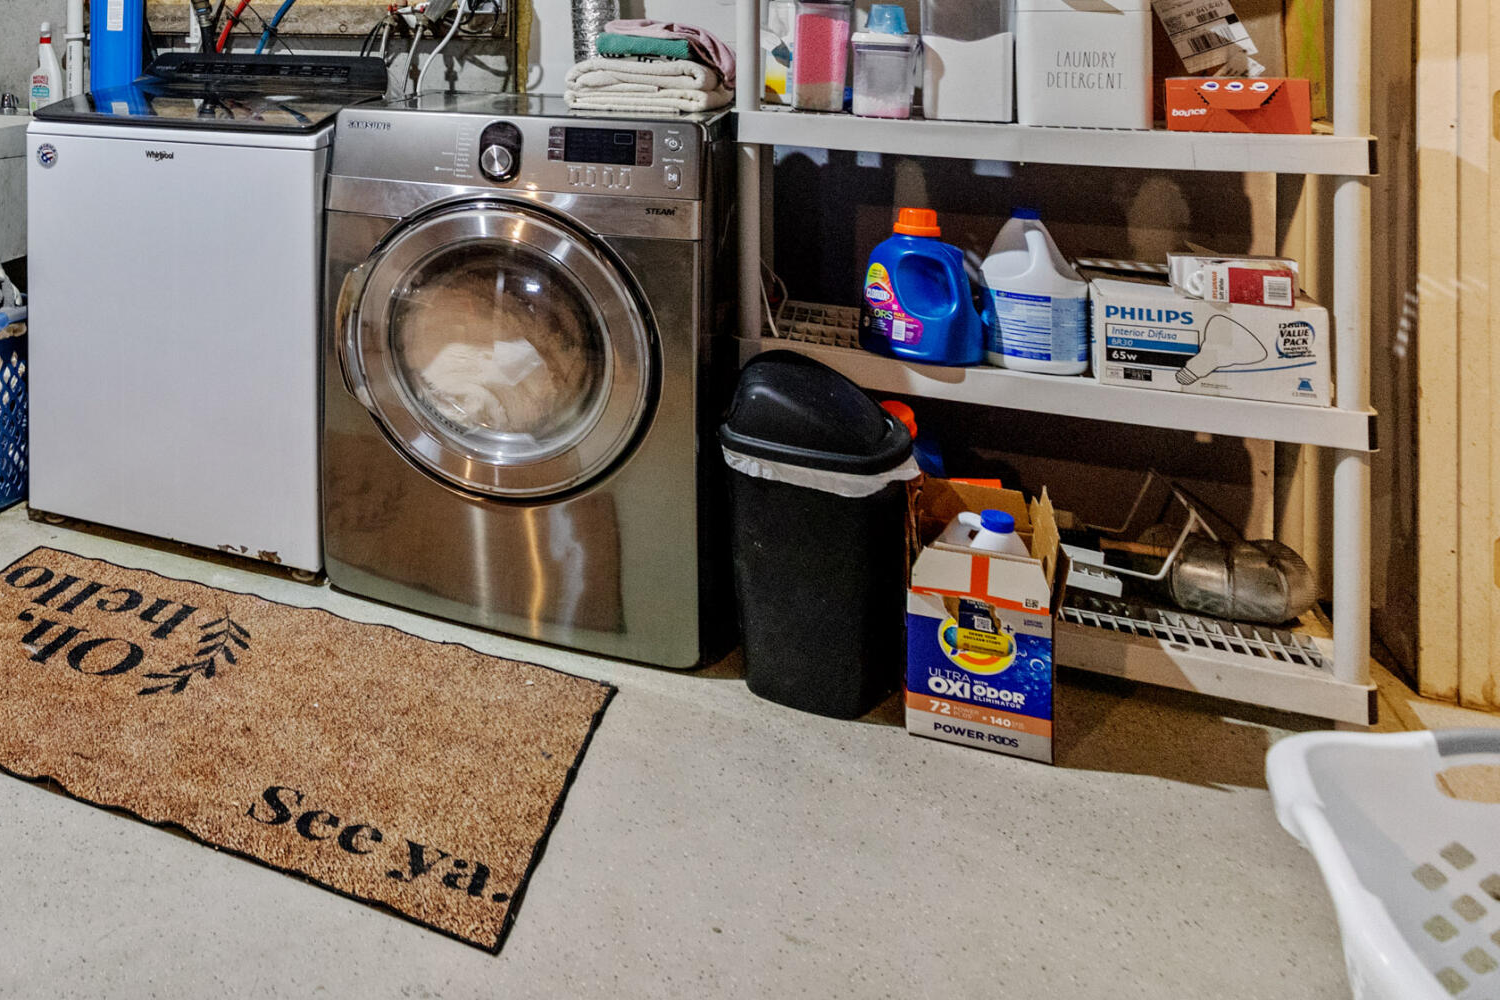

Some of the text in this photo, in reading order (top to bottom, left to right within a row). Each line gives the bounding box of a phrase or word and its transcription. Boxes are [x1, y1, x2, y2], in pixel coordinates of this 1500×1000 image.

[1057, 51, 1116, 68] LAUNDRY
[1047, 71, 1123, 89] DETERGENT
[1172, 107, 1207, 117] bounce
[348, 120, 391, 131] SAMSUNG
[145, 150, 174, 162] Whirlpool
[645, 208, 676, 216] STEAM
[1105, 305, 1194, 325] PHILIPS
[1111, 326, 1177, 340] Interior Difusa
[1279, 330, 1310, 338] VALUE
[1111, 338, 1133, 347] BR30
[1283, 338, 1308, 346] PACK
[1111, 351, 1137, 361] 65w
[5, 565, 197, 640] hello
[18, 610, 147, 677] Oh,
[928, 666, 971, 682] ULTRA
[928, 676, 971, 699] OXI
[973, 685, 1025, 705] ODOR
[953, 705, 980, 715] POWER
[974, 696, 1021, 709] ELIMINATOR
[929, 700, 950, 715] 72
[990, 716, 1011, 727] 140
[933, 722, 1019, 748] POWER PODS
[247, 785, 511, 905] See ya.
